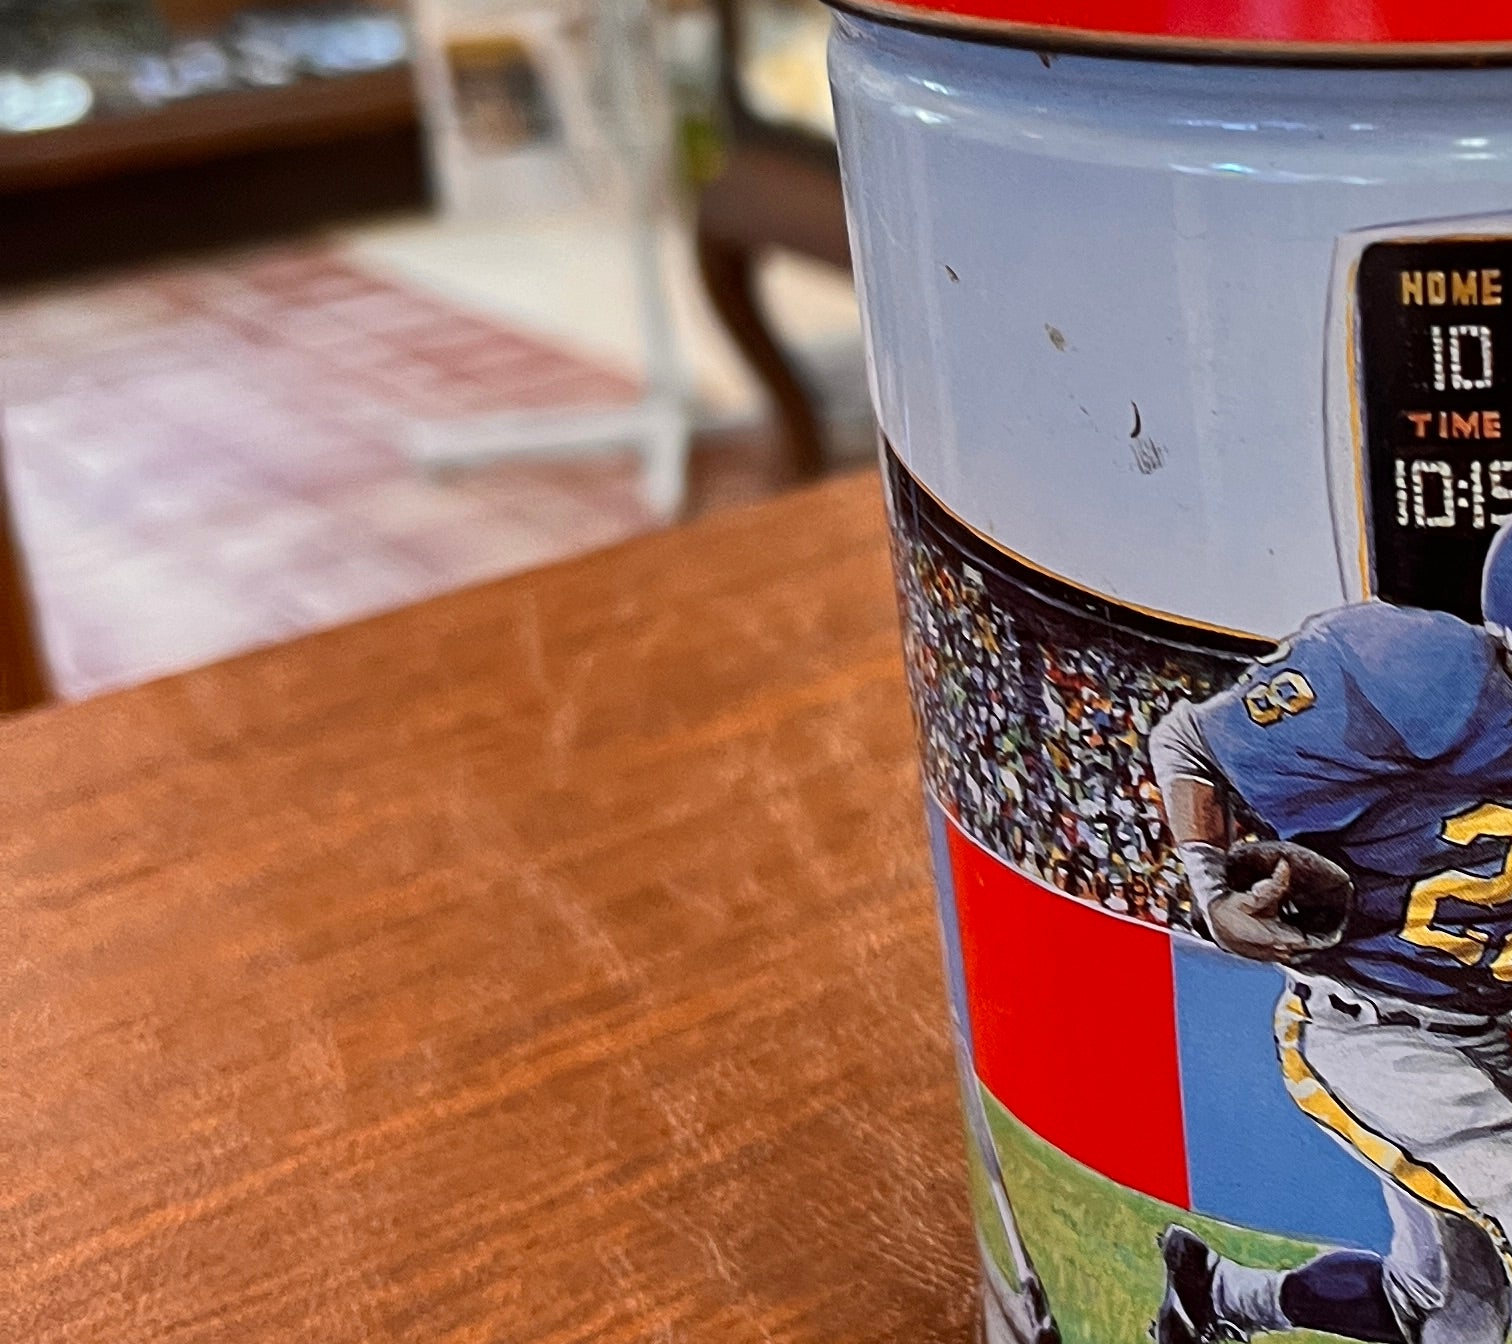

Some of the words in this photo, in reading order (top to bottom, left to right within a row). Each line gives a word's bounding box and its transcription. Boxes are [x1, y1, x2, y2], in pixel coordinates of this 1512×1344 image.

[1400, 268, 1502, 306] HOME
[1430, 324, 1493, 391] 10
[1406, 410, 1501, 439] TIME
